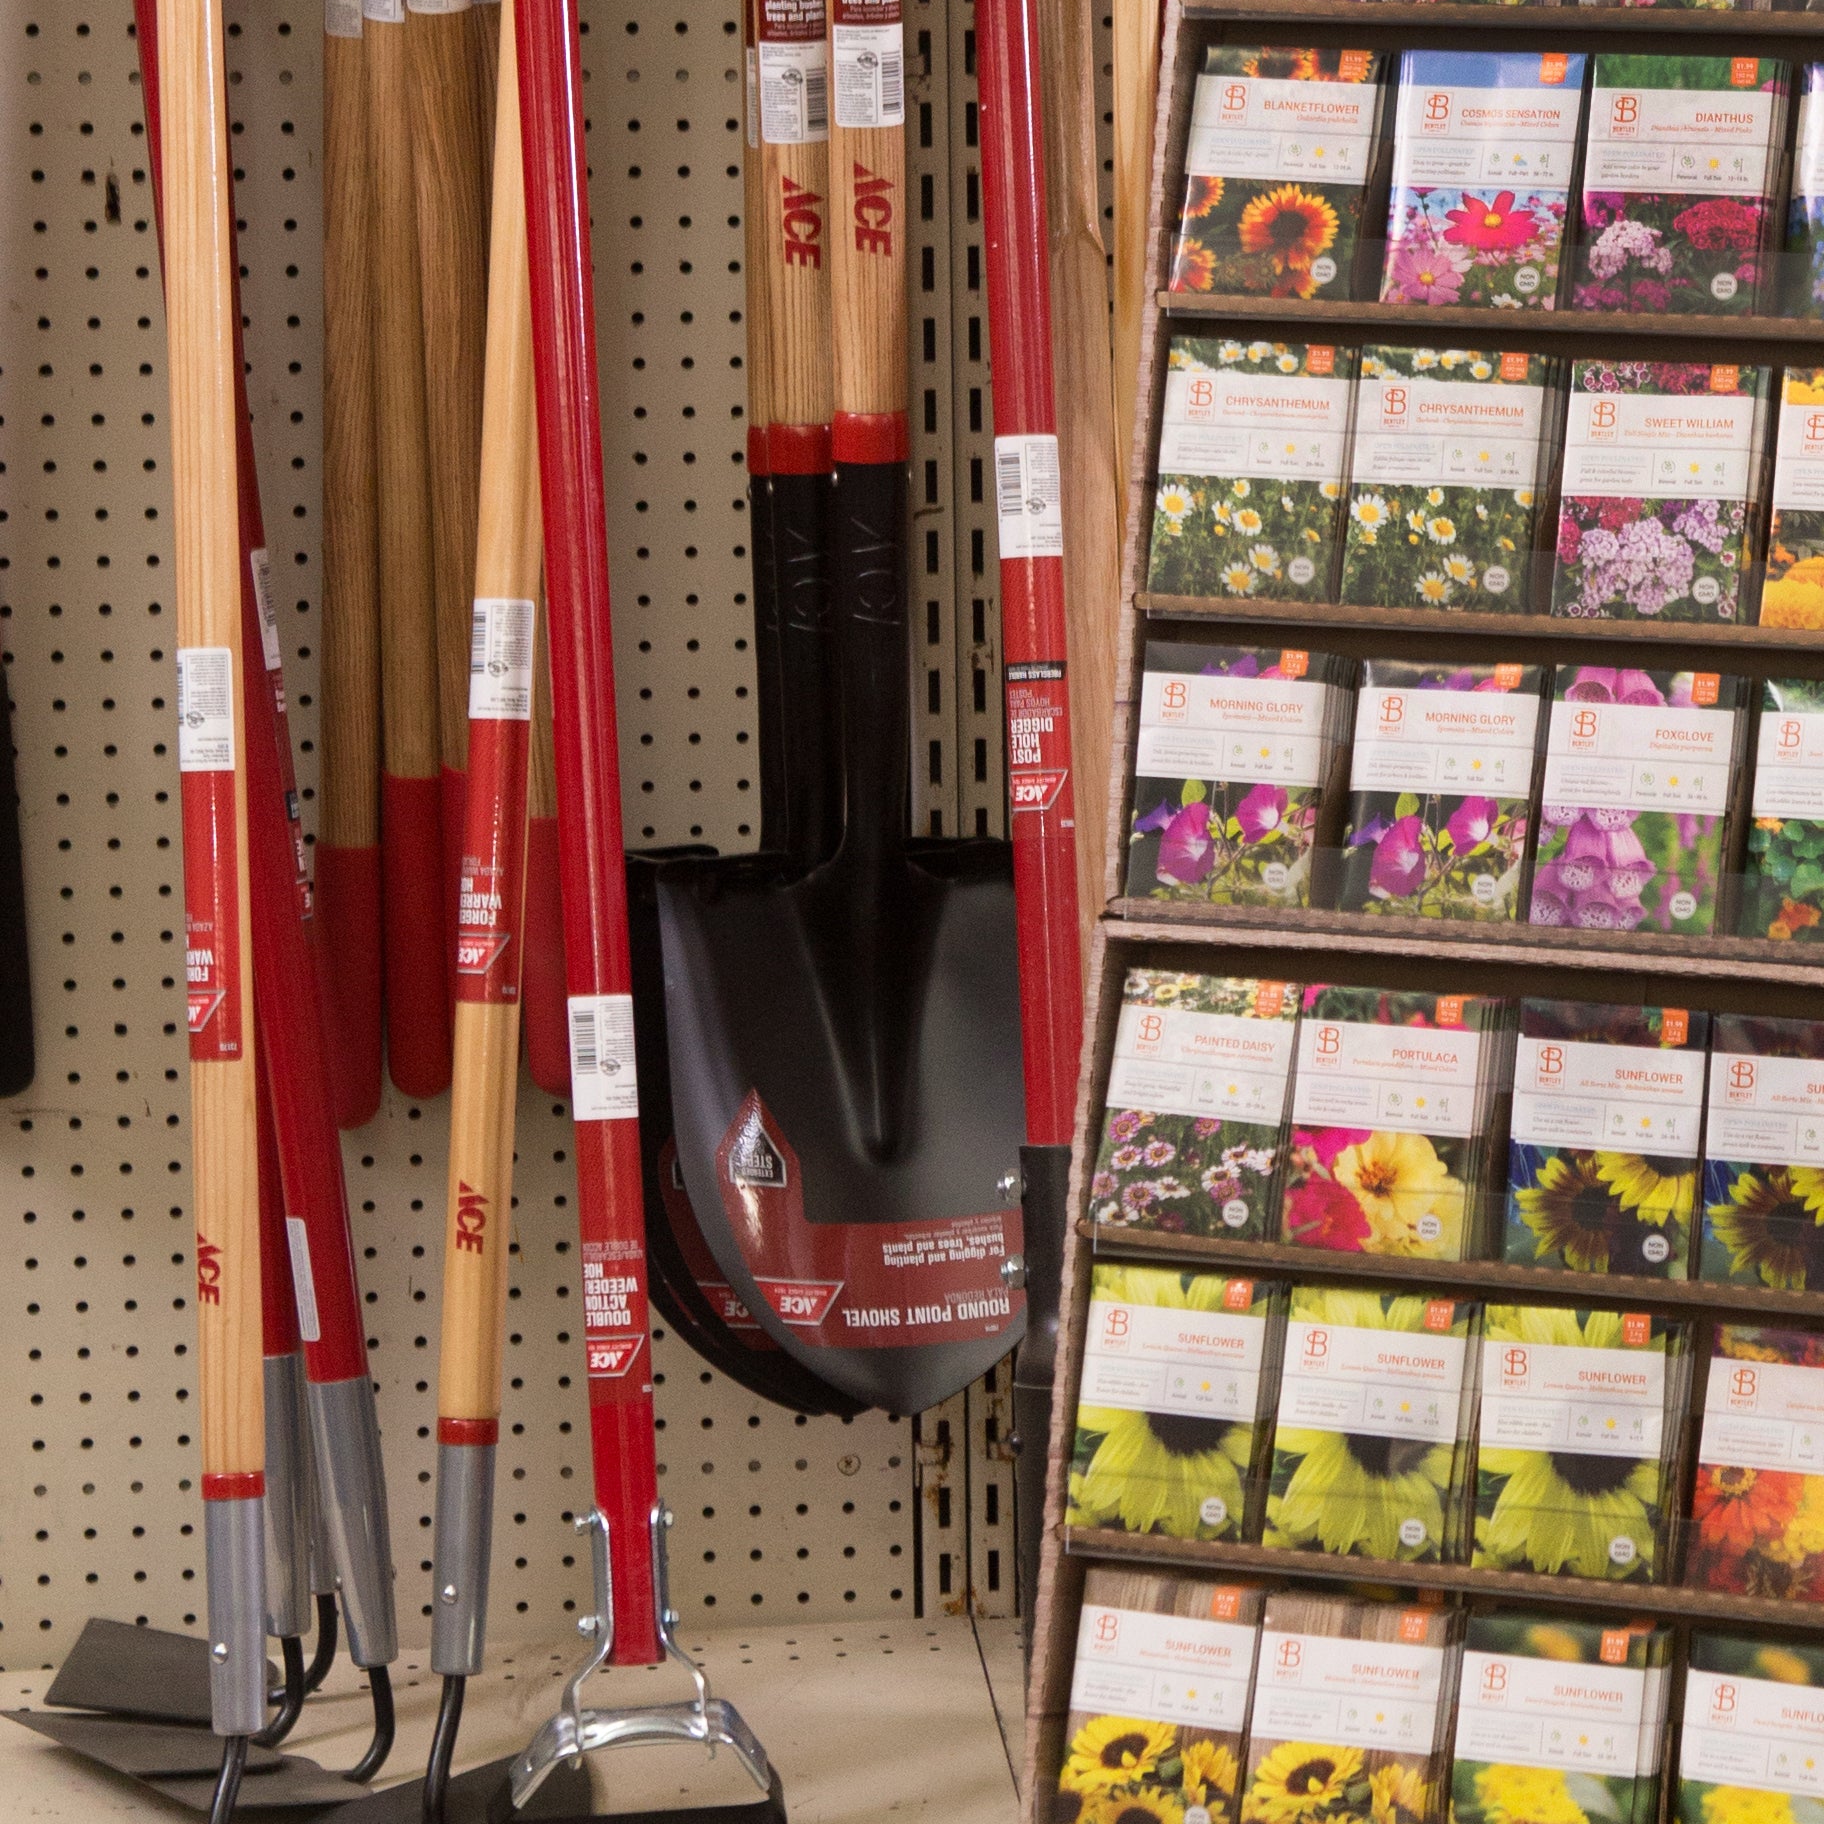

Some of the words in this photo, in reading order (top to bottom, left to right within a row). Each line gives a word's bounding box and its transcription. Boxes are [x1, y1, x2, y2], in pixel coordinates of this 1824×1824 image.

[1264, 101, 1360, 115] BLANKETFLOWER
[1462, 108, 1502, 119] COSMOS
[1506, 109, 1560, 120] SENSATION
[1696, 113, 1753, 123] DIANTHUS
[853, 159, 896, 258] ACE
[782, 175, 824, 271] ACE
[1225, 396, 1330, 410] CHRYSANTHEMUM
[1419, 404, 1524, 417] CHRYSANTHEMUM
[1645, 418, 1683, 428] SWEET
[1686, 419, 1734, 429] WILLIAM
[1209, 699, 1263, 711] MORNING
[1266, 702, 1303, 713] GLORY
[1010, 717, 1054, 734] DIGGER
[1426, 713, 1476, 723] MORNING
[1480, 714, 1516, 725] GLORY
[1011, 733, 1040, 749] HOLE
[1655, 729, 1713, 742] FOXGLOVE
[1012, 748, 1042, 765] POST
[1014, 784, 1048, 802] ACE
[1194, 1035, 1240, 1049] PAINTED
[1243, 1040, 1274, 1051] DAISY
[1392, 1049, 1457, 1064] PORTULACA
[1615, 1070, 1683, 1084] SUNFLOWER
[457, 1179, 490, 1255] ACE
[928, 1252, 946, 1265] and
[196, 1231, 225, 1307] ACE
[586, 1294, 627, 1311] ACTION
[779, 1296, 817, 1314] ACE
[958, 1298, 1010, 1320] ROUND
[585, 1309, 631, 1328] DOUBLE
[842, 1308, 900, 1328] SHOVEL
[906, 1305, 951, 1326] POINT
[1178, 1334, 1244, 1349] SUNFLOWER
[589, 1349, 624, 1371] ACE
[1377, 1354, 1445, 1370] SUNFLOWER
[1578, 1372, 1647, 1385] SUNFLOWER
